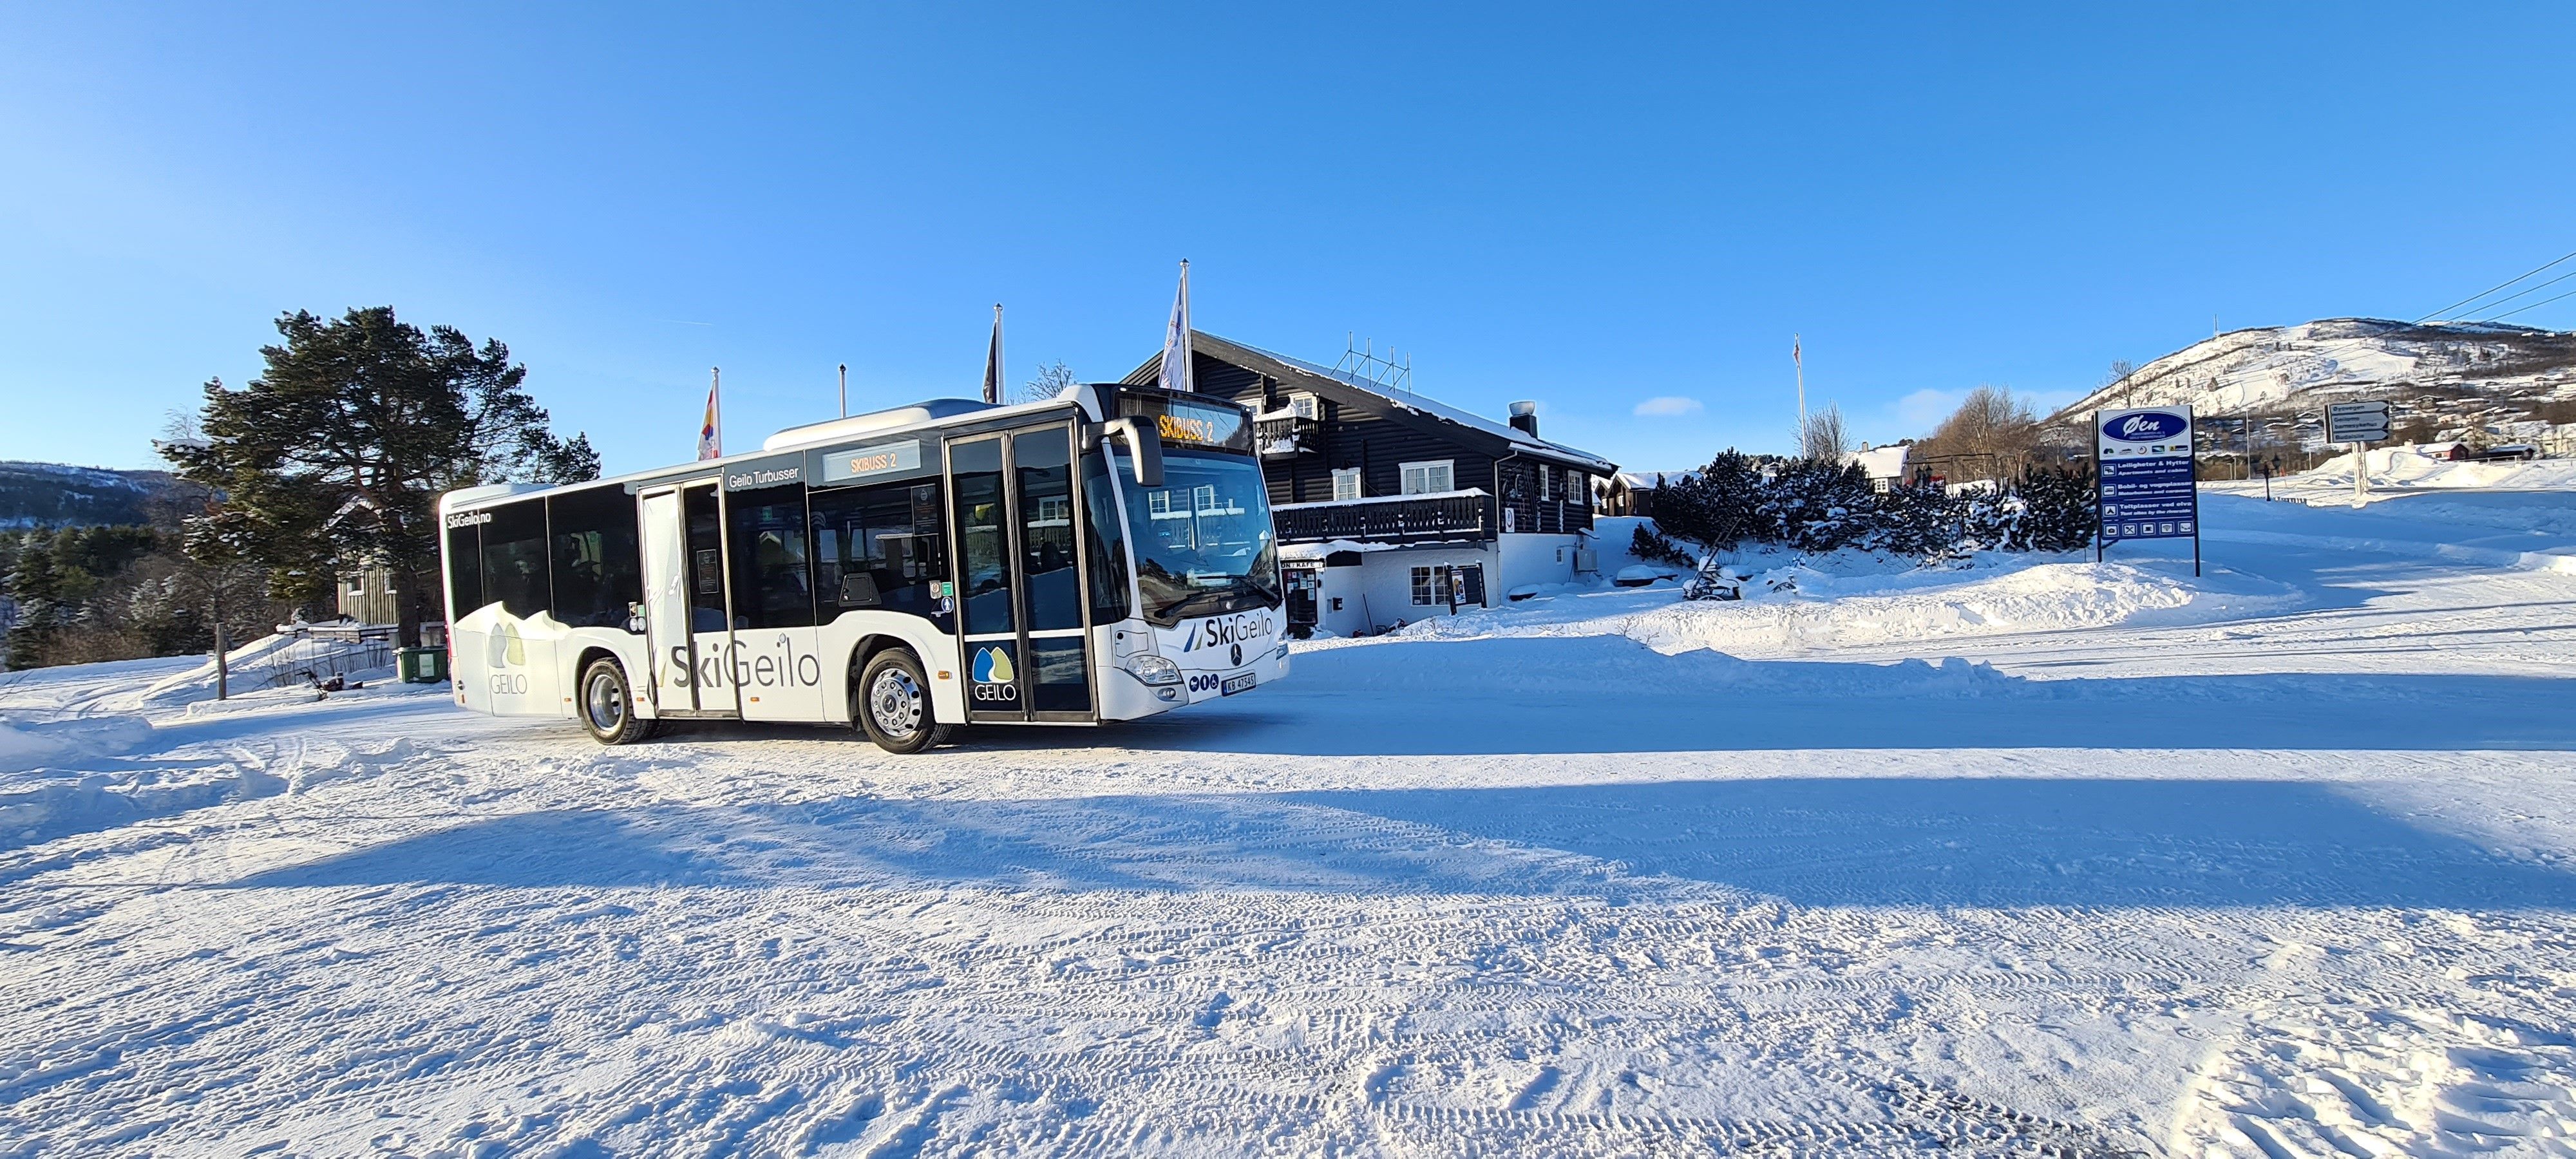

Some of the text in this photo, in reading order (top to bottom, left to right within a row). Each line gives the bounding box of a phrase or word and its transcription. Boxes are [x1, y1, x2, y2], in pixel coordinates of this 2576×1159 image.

[1160, 415, 1214, 442] SKIBUSS 2
[2123, 415, 2160, 437] Øen
[851, 453, 896, 473] SKIBUSS 2
[729, 468, 799, 487] Geilo Turbusser
[448, 511, 491, 529] SkiGeilo.no
[1206, 610, 1273, 648] SkiGeilo
[671, 637, 820, 688] SkiGeilo
[491, 674, 527, 694] GEILO
[974, 684, 1016, 701] GEILO
[1227, 675, 1254, 692] KB 47545
